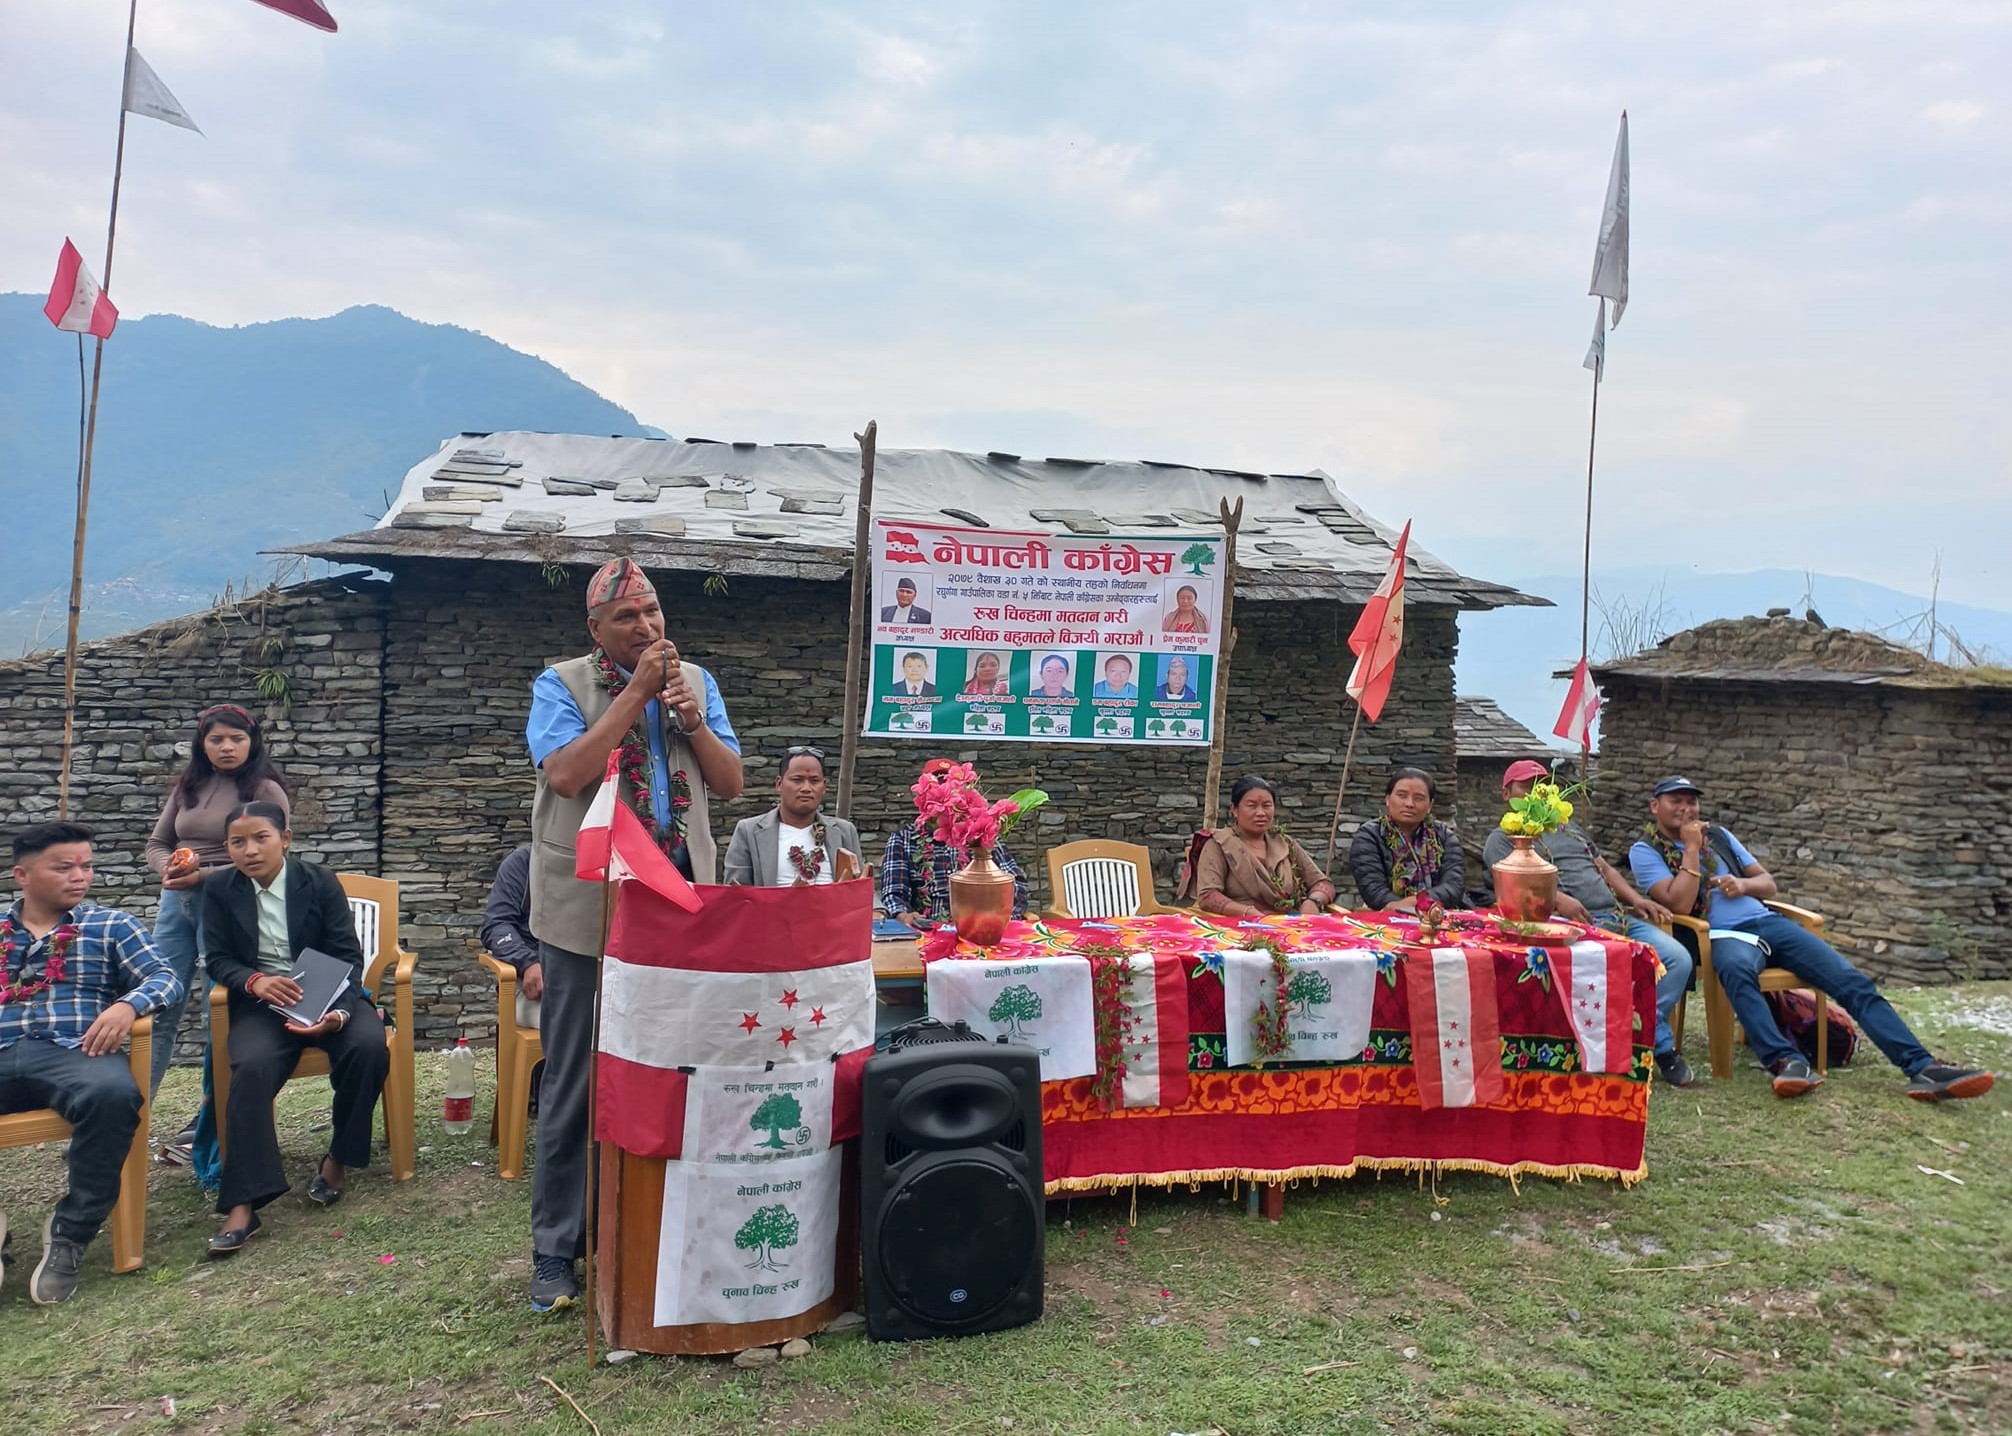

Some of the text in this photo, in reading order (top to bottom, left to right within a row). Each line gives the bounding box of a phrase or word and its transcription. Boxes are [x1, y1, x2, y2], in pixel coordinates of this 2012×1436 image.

[933, 535, 1176, 575] नेपाली काँग्रेस
[977, 572, 1001, 584] वैशाख
[1005, 577, 1017, 585] ३०
[1020, 574, 1033, 586] गते
[1037, 575, 1048, 587] को
[1051, 577, 1082, 588] स्थानीय
[1085, 578, 1108, 589] तहको
[1111, 579, 1147, 590] निर्वाचनमा
[1055, 592, 1074, 602] नेपाली
[973, 606, 1128, 623] रुख चिन्हमा मतदान गरी
[939, 626, 998, 643] अत्यधिक
[1003, 627, 1055, 646] बहुमतले
[1059, 628, 1099, 644] विजयी
[984, 967, 1011, 979] नेपाली
[744, 1082, 773, 1093] चिन्हमा
[778, 1081, 803, 1093] मतदान
[736, 1179, 802, 1197] नेपाली कांग्रेस
[722, 1279, 801, 1299] चुनाव चिन्ह रुख
